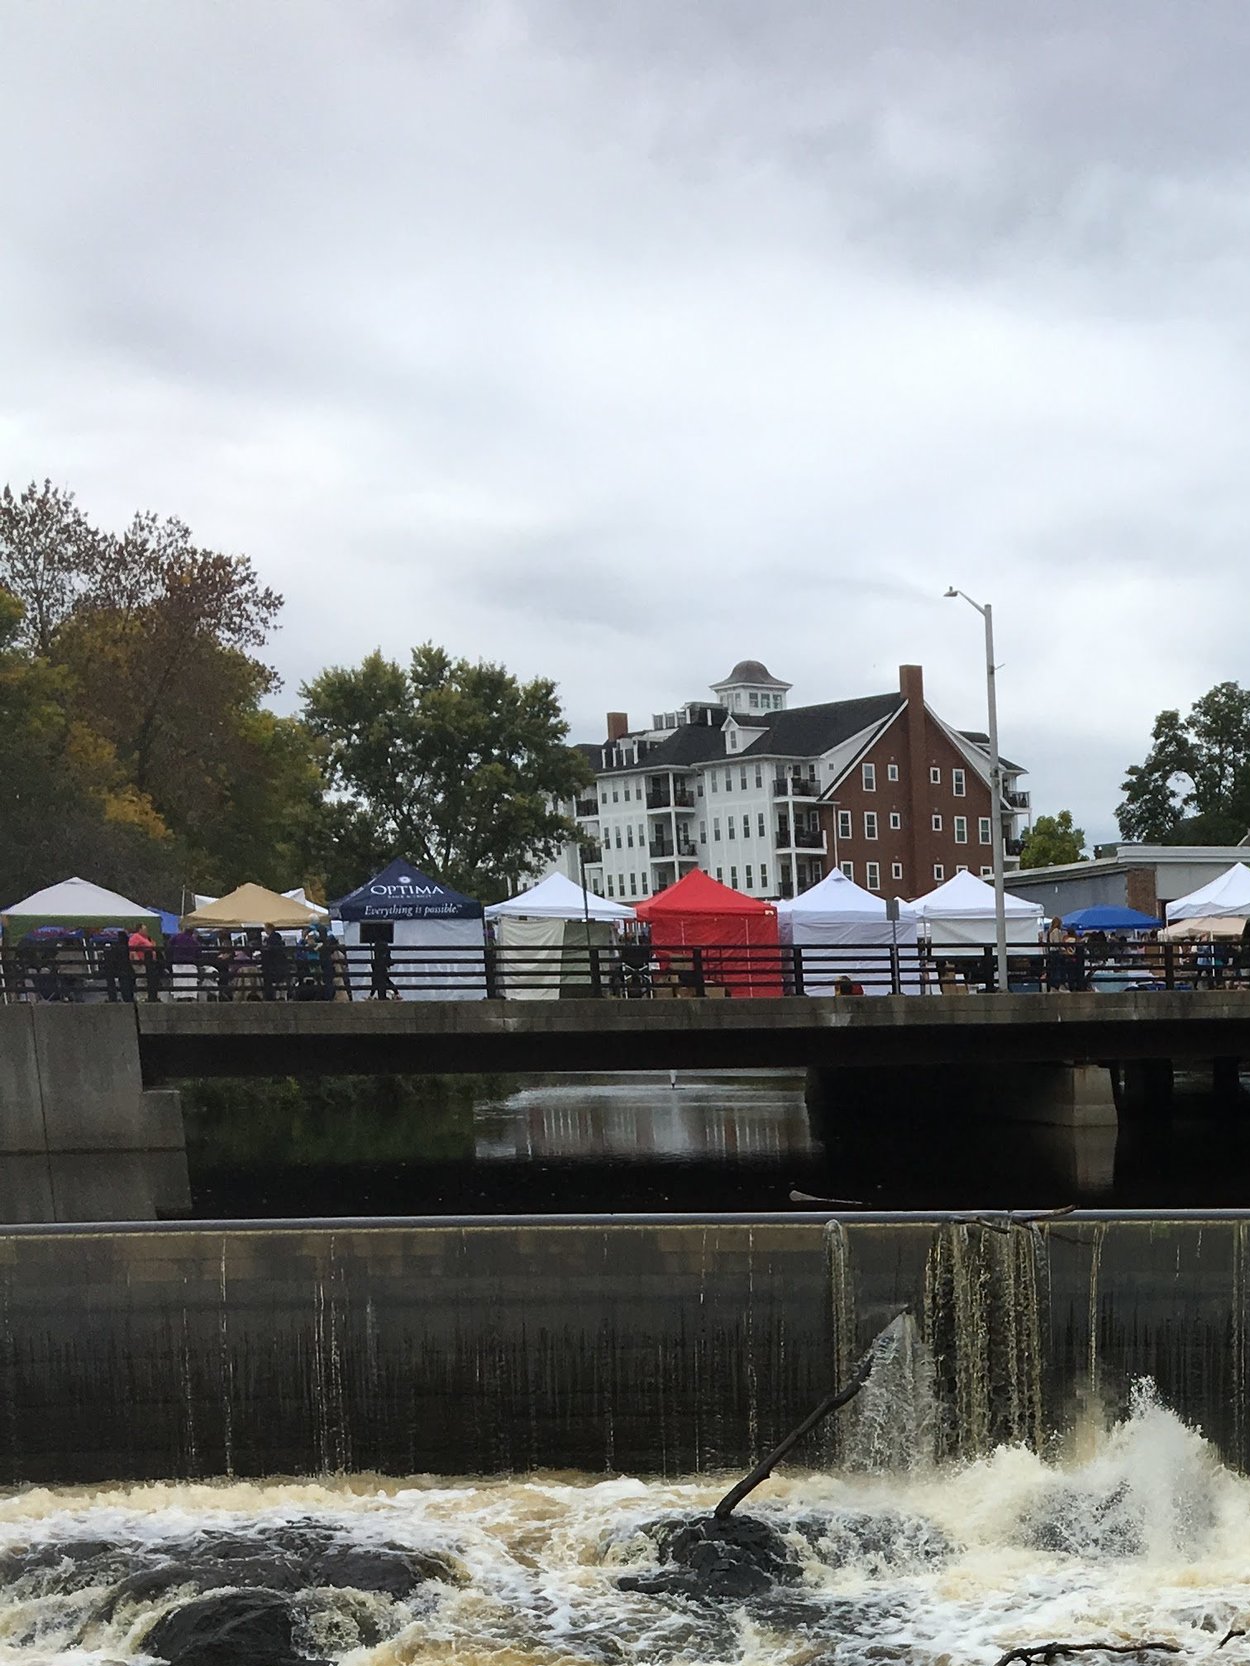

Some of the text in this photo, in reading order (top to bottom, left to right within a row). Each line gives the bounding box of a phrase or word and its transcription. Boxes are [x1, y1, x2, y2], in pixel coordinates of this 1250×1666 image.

[370, 885, 444, 895] OPTIMA
[364, 904, 413, 917] Everything
[415, 904, 422, 914] is
